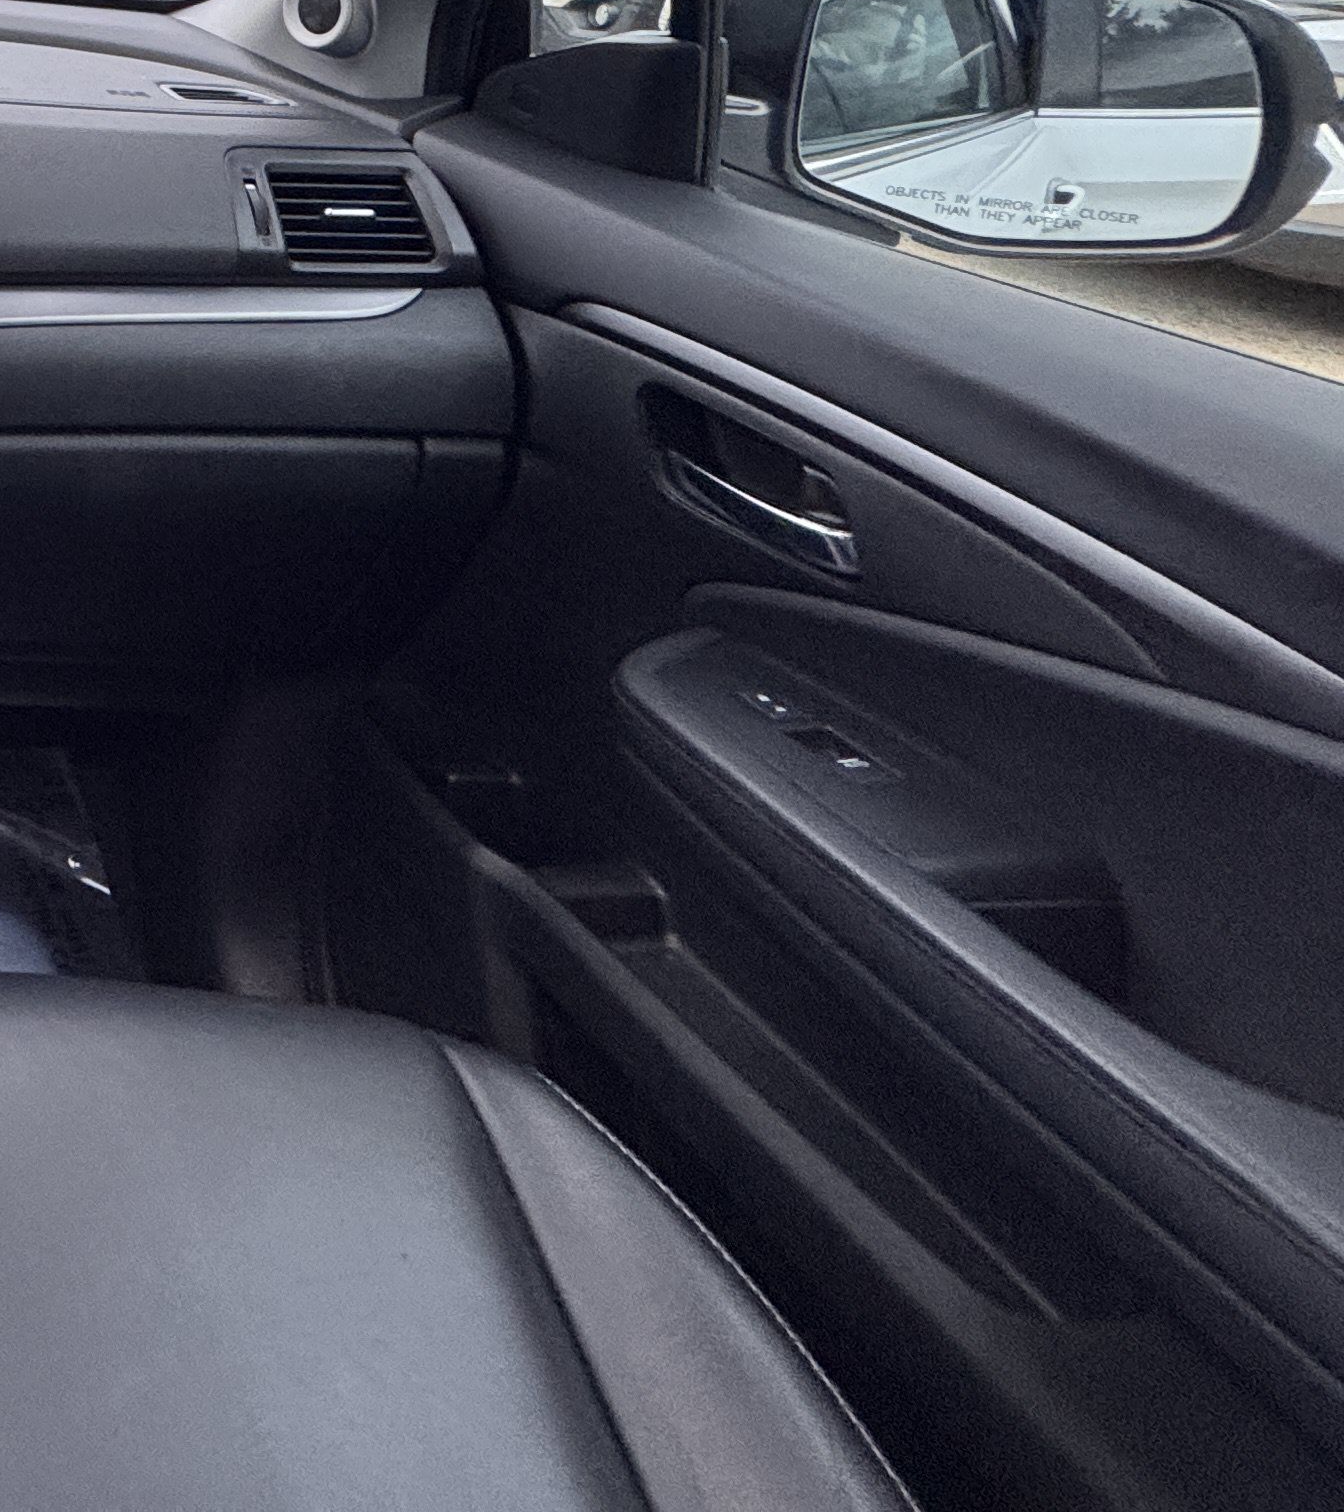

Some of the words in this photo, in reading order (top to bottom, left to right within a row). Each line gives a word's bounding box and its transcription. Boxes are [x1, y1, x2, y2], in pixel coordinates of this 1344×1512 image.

[885, 186, 946, 202] OBJECTS
[955, 194, 969, 205] IN
[979, 197, 1034, 213] MIRROR
[1078, 208, 1140, 225] CLOSER
[934, 202, 970, 218] THAN
[980, 209, 1017, 224] THEY
[1022, 214, 1083, 232] APPEAR
